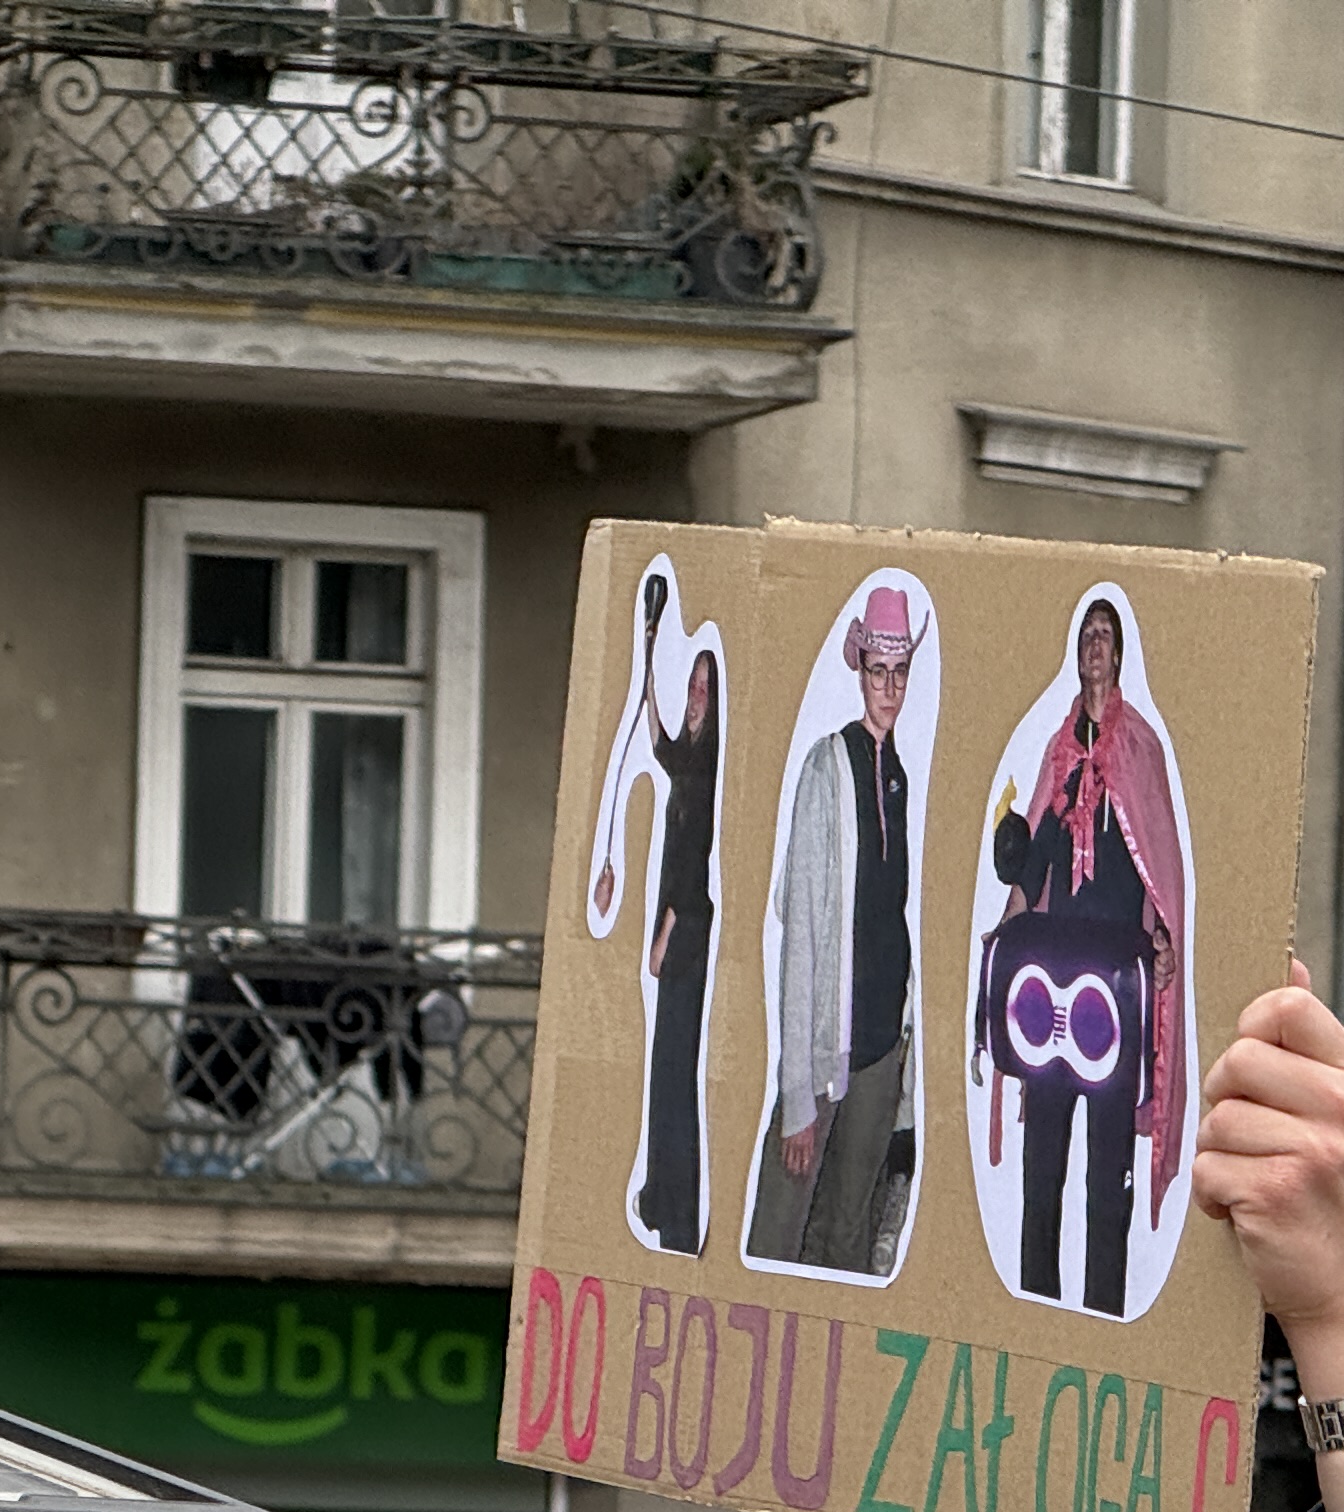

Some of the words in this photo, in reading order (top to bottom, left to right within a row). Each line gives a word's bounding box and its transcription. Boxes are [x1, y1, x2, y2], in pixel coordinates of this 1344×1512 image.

[135, 1297, 491, 1402] żabka
[516, 1266, 608, 1464] DO
[623, 1285, 845, 1512] BOJU
